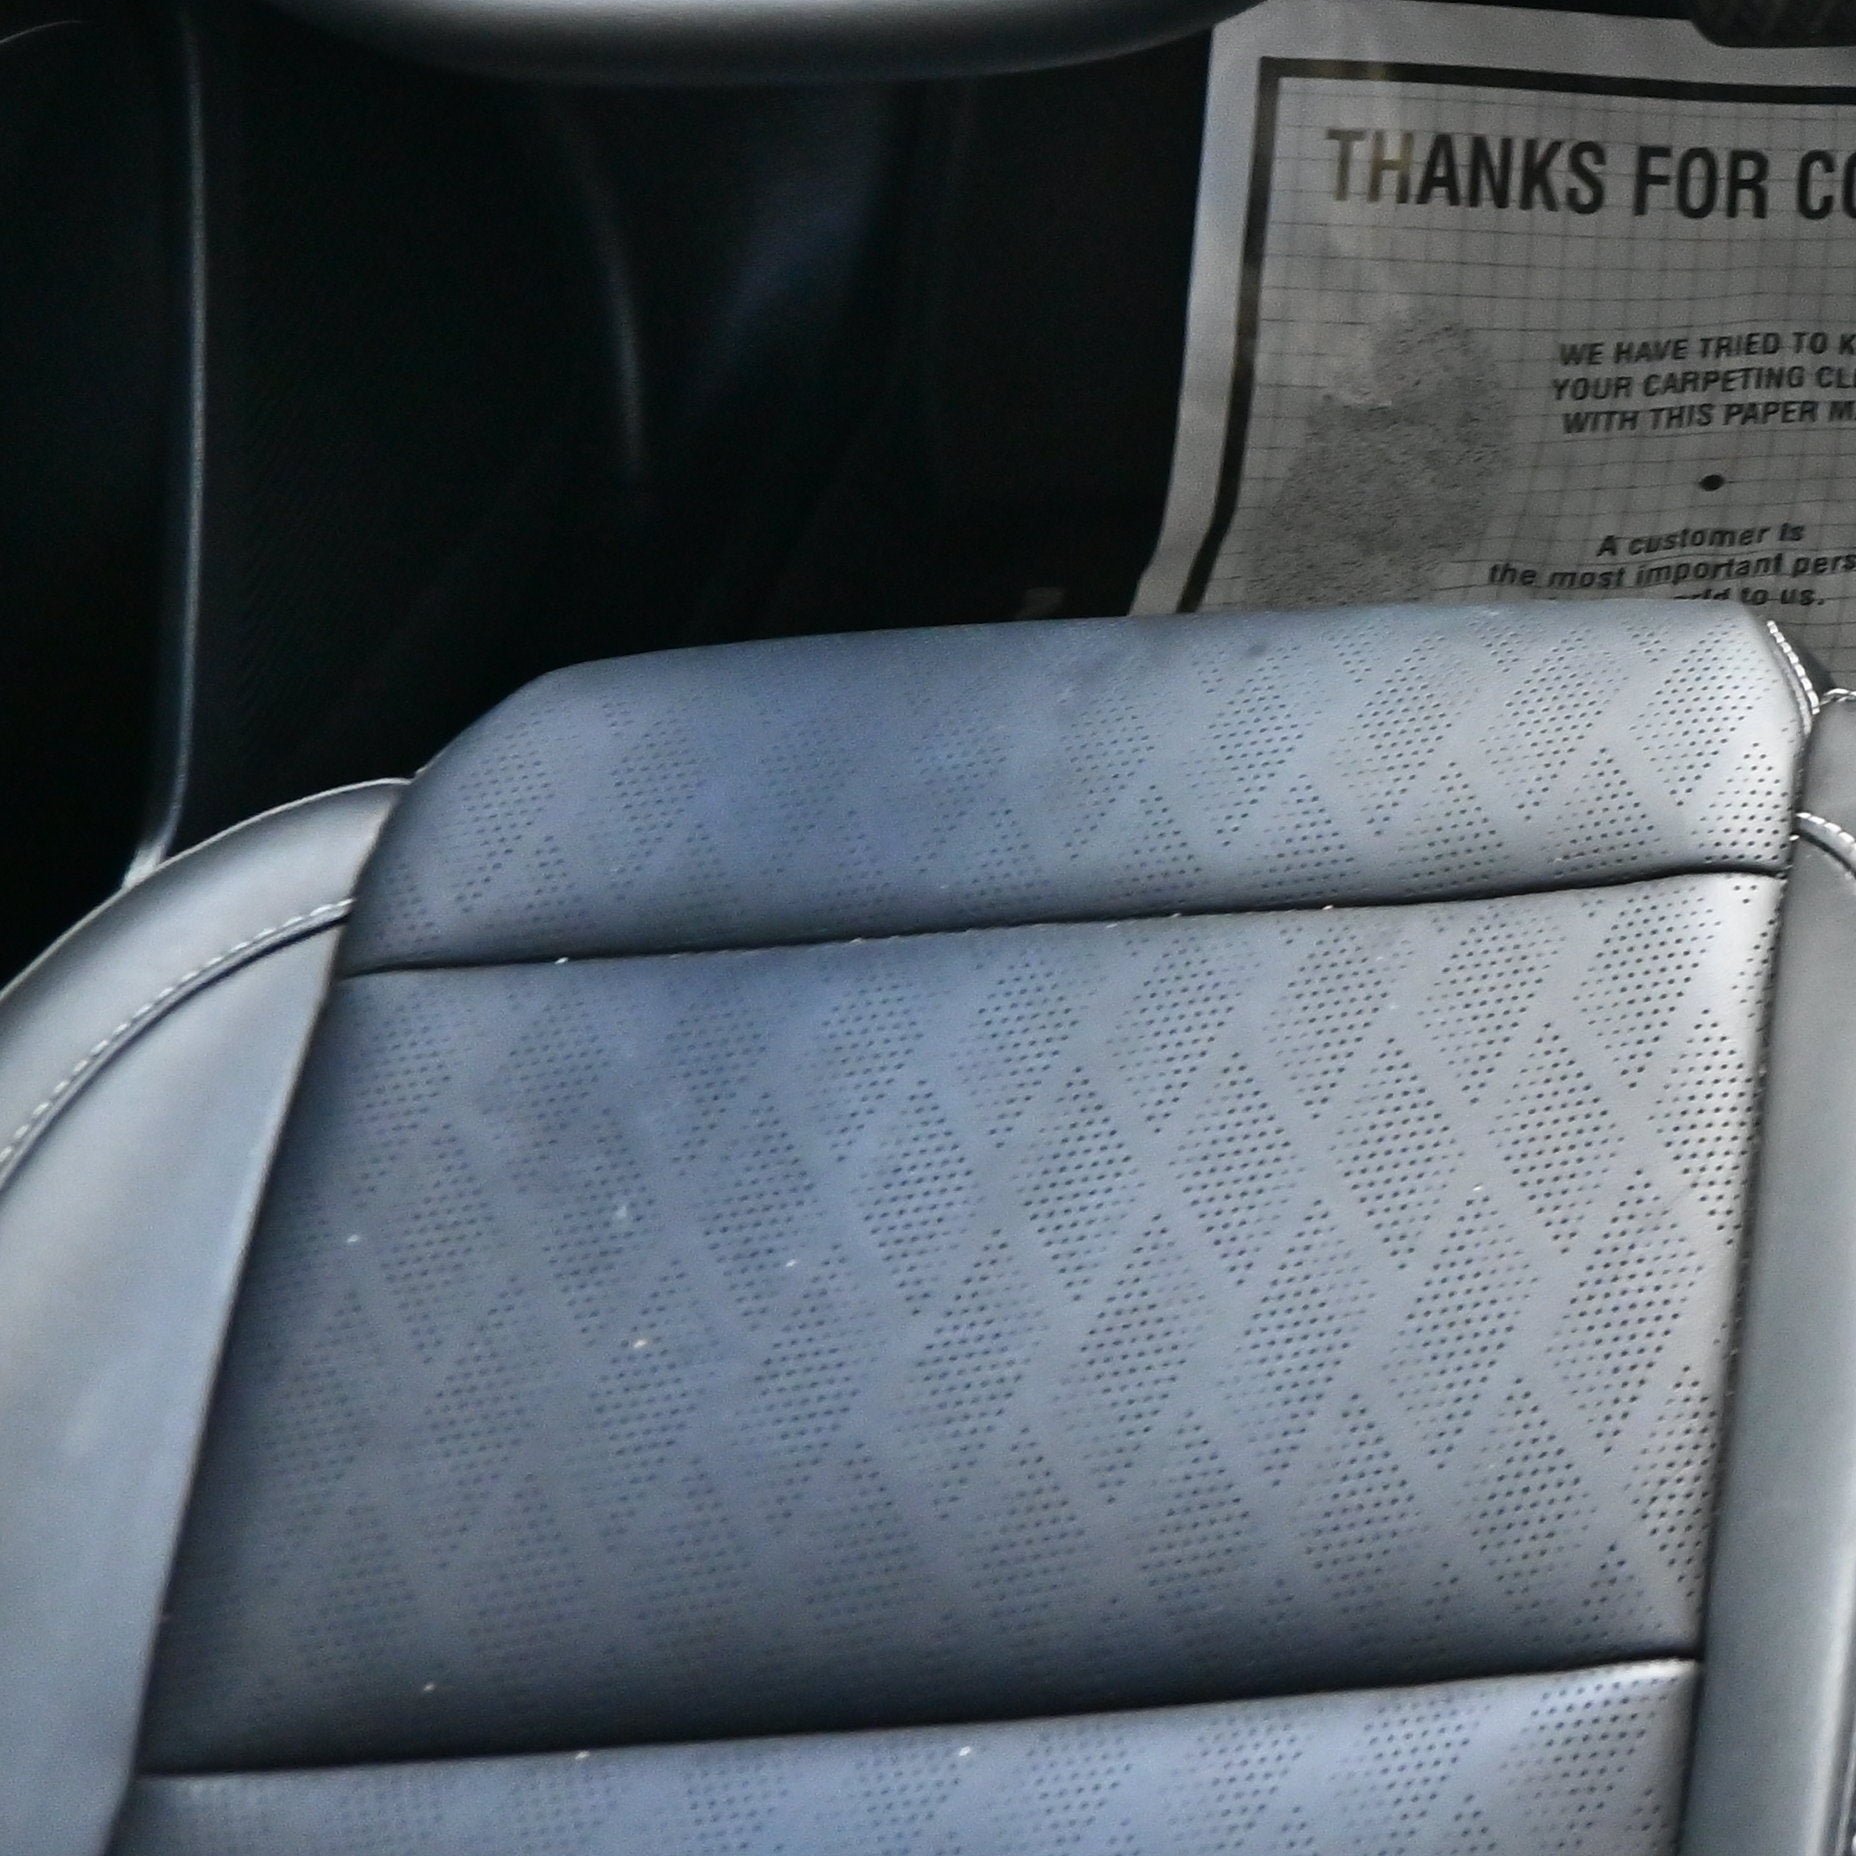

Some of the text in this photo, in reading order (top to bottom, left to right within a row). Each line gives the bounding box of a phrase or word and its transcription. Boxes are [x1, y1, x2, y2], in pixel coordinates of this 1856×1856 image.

[1326, 128, 1607, 214] THANKS
[1633, 146, 1770, 219] FOR
[1559, 342, 1603, 365] WE
[1614, 339, 1687, 363] HAVE
[1700, 332, 1780, 358] TRIED
[1793, 332, 1828, 354] TO
[1553, 376, 1632, 400] YOUR
[1643, 366, 1805, 396] CARPETING
[1563, 408, 1638, 434] WITH
[1651, 403, 1713, 430] THIS
[1723, 401, 1818, 425] PAPER
[1597, 523, 1805, 557] A customer is
[1488, 563, 1536, 585] the
[1549, 567, 1626, 589] most
[1636, 554, 1782, 584] important
[1740, 587, 1769, 606] to
[1779, 589, 1826, 606] us.
